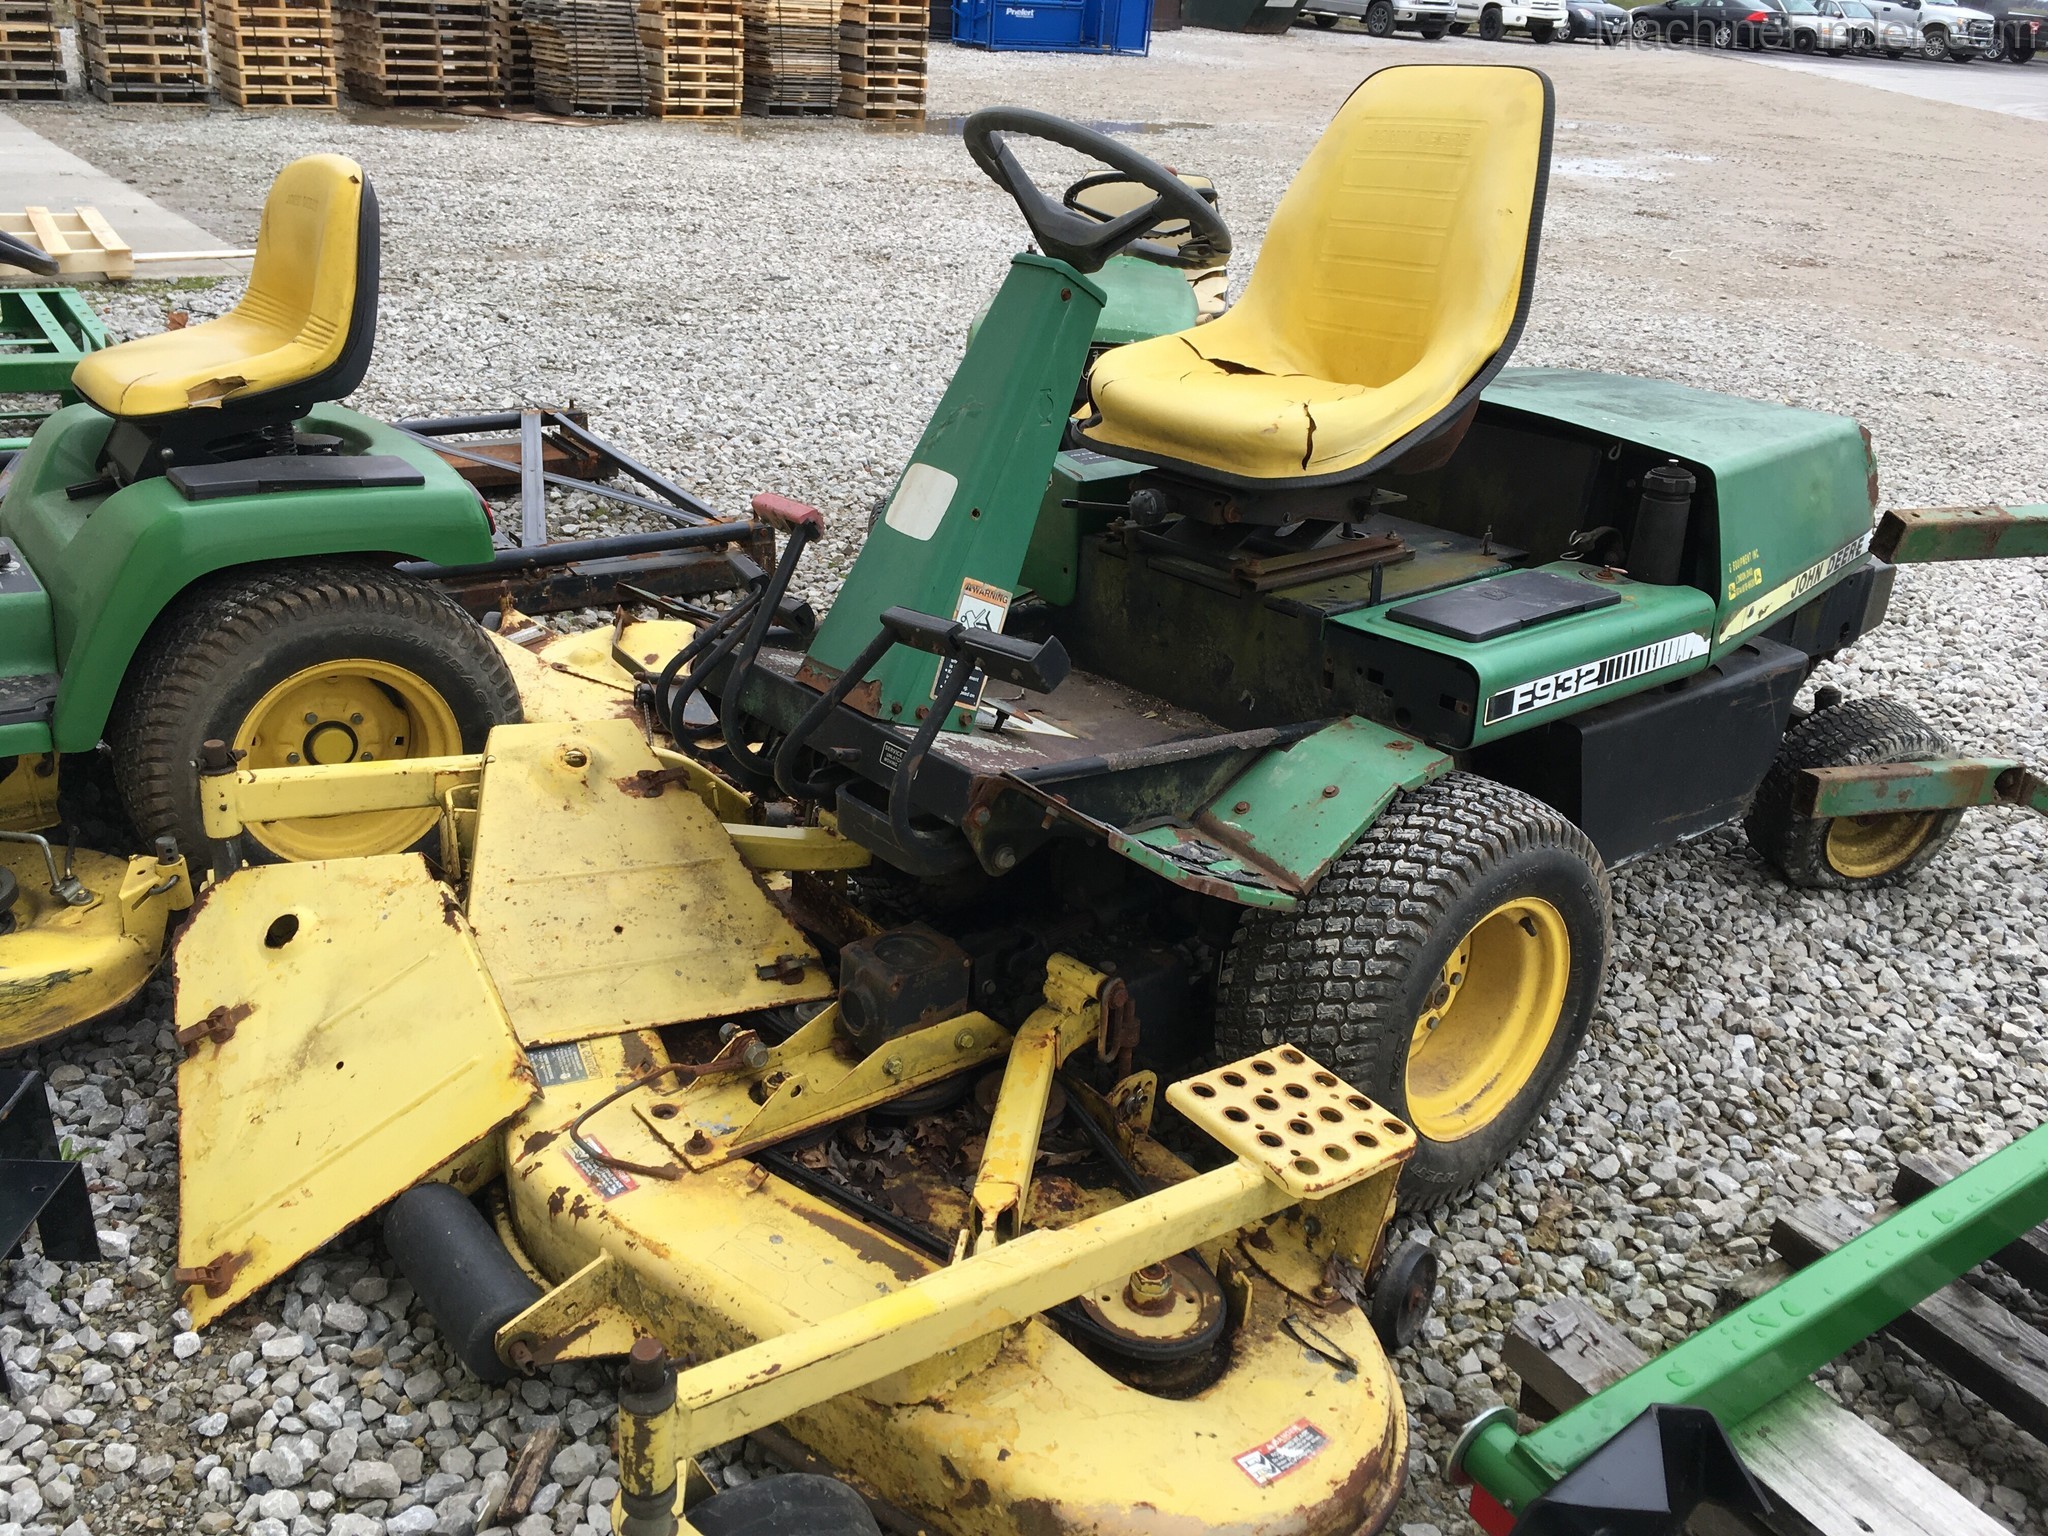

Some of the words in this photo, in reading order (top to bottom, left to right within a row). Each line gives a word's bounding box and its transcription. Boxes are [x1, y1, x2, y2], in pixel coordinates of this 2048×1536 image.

[1791, 562, 1824, 598] JOHN
[1826, 536, 1865, 575] DEERE
[972, 584, 1009, 604] WARNING
[344, 625, 429, 648] MULTI
[436, 649, 488, 704] TRAC
[1511, 662, 1601, 715] F932
[885, 744, 904, 758] SERVICE
